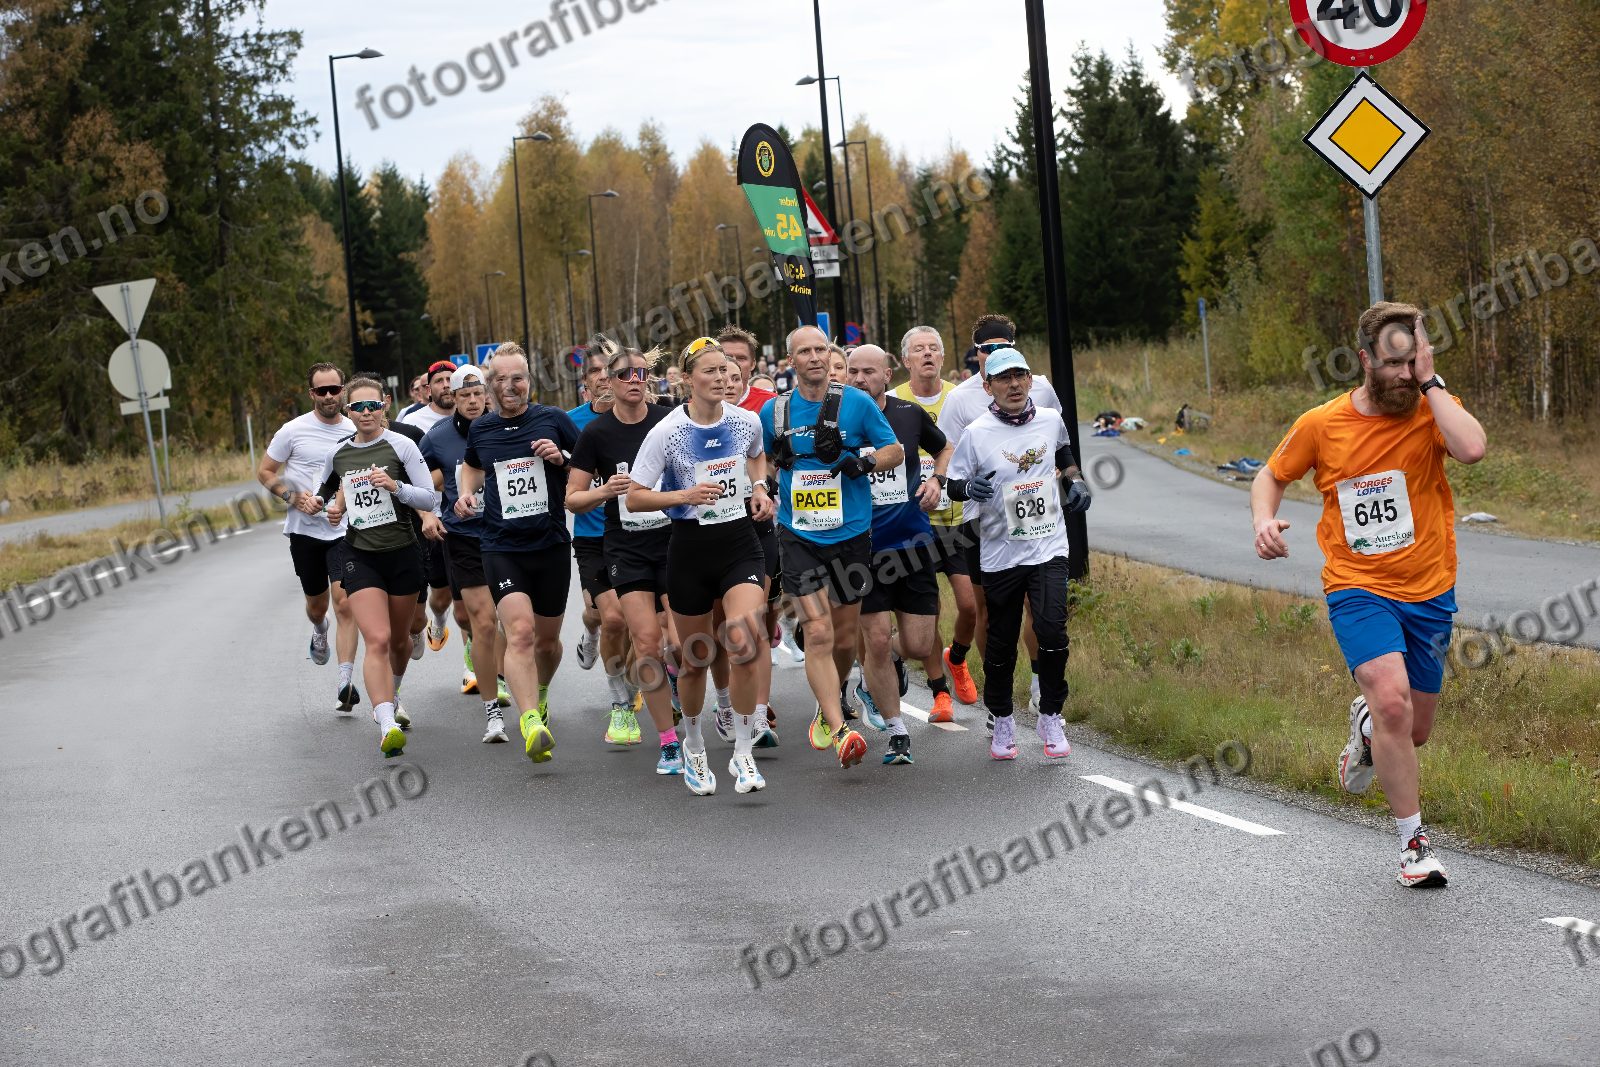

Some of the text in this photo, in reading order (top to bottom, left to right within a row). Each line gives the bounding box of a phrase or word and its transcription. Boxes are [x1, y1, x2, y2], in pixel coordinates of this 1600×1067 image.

[505, 460, 535, 470] NORGES
[508, 467, 530, 475] LØPET
[707, 460, 736, 471] NORGES
[709, 467, 733, 477] LØPET
[800, 473, 832, 481] NORGES
[507, 476, 537, 497] 524
[718, 477, 737, 499] 25
[1013, 480, 1044, 491] NORGES
[1351, 476, 1393, 490] NORGES
[1357, 485, 1388, 497] LØPET
[354, 488, 382, 508] 452
[795, 491, 837, 508] PACE
[1015, 497, 1046, 520] 628
[1354, 498, 1398, 527] 645
[1374, 531, 1412, 544] Aurskog
